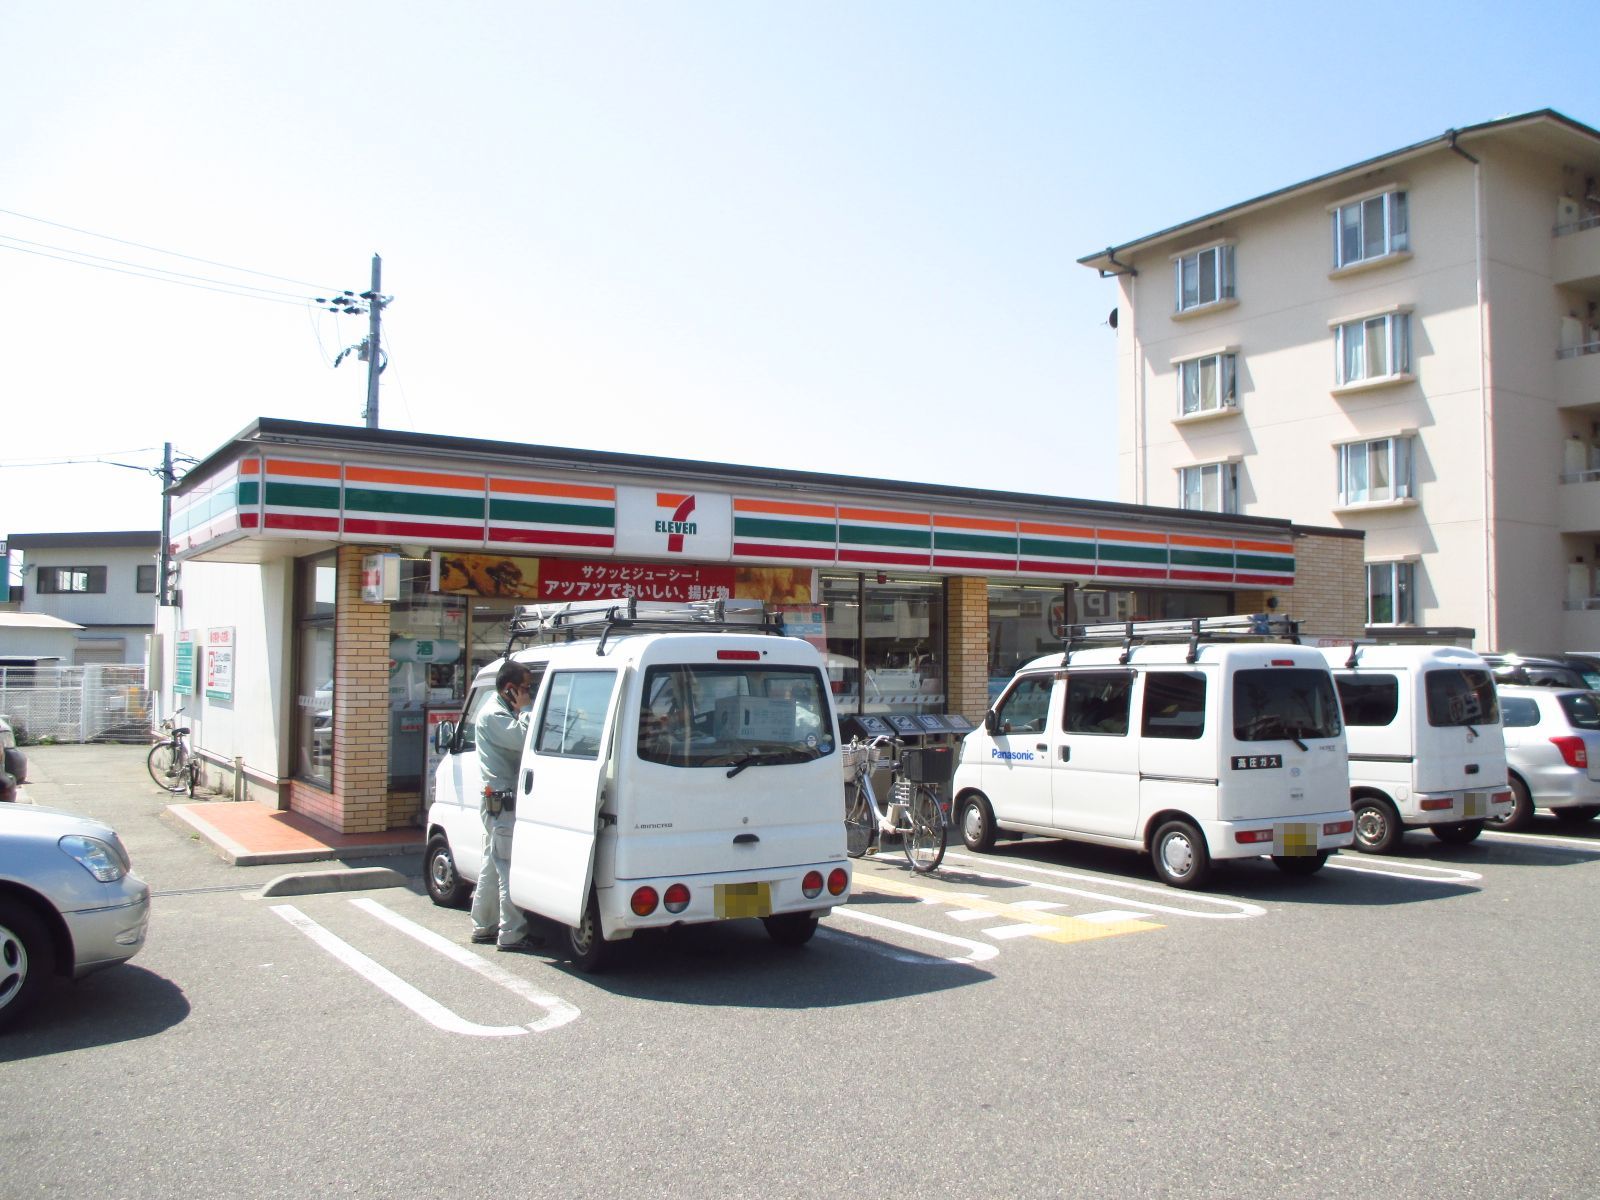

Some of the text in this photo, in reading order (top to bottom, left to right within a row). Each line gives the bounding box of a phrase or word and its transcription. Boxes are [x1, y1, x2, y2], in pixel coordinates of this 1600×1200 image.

[656, 493, 696, 552] 7
[581, 565, 701, 582] サクッとジューシー！
[544, 580, 730, 601] アツアツでおいしい、揚げ物
[416, 640, 433, 655] 酒
[991, 748, 1034, 761] Panasonic
[1237, 757, 1277, 768] 高圧ガス
